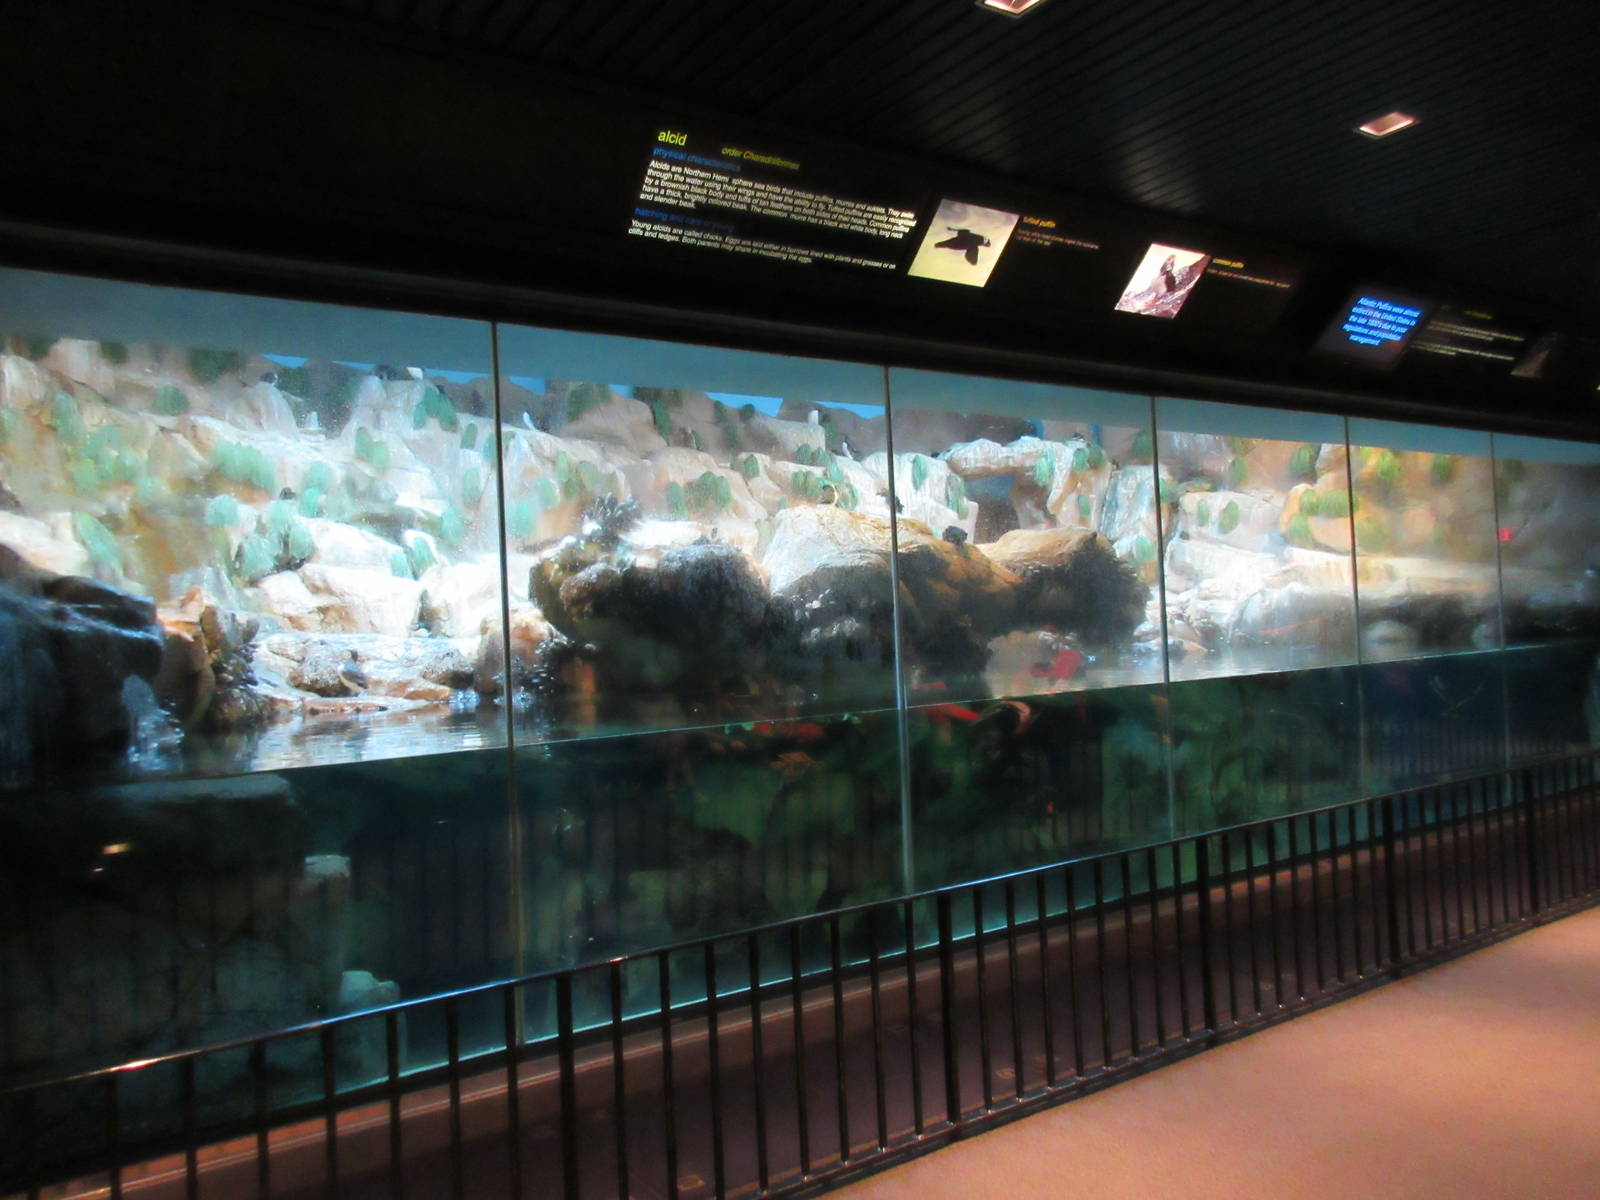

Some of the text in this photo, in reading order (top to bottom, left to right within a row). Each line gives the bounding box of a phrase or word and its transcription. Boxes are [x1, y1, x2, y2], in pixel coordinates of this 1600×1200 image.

[658, 130, 687, 146] alcid
[722, 148, 743, 158] order
[647, 169, 673, 180] through
[674, 174, 684, 182] the
[686, 177, 703, 185] water
[704, 181, 721, 190] using
[722, 185, 737, 193] their
[738, 188, 755, 197] wings
[756, 191, 768, 199] and
[650, 160, 670, 171] Alcids
[683, 167, 711, 178] Northern
[766, 184, 781, 193] birds
[781, 187, 793, 195] that
[888, 208, 900, 217] They
[645, 177, 653, 185] by
[660, 180, 690, 191] brownish
[691, 186, 707, 194] black
[709, 189, 724, 199] body
[869, 221, 893, 230] Common
[654, 196, 678, 205] slender
[643, 185, 659, 194] have
[666, 190, 683, 198] thick,
[684, 193, 707, 204] brightly
[879, 230, 891, 238] long
[629, 228, 643, 236] cliffs
[682, 237, 697, 245] Both
[632, 220, 652, 230] Young
[653, 224, 671, 232] alcids
[684, 229, 702, 238] called
